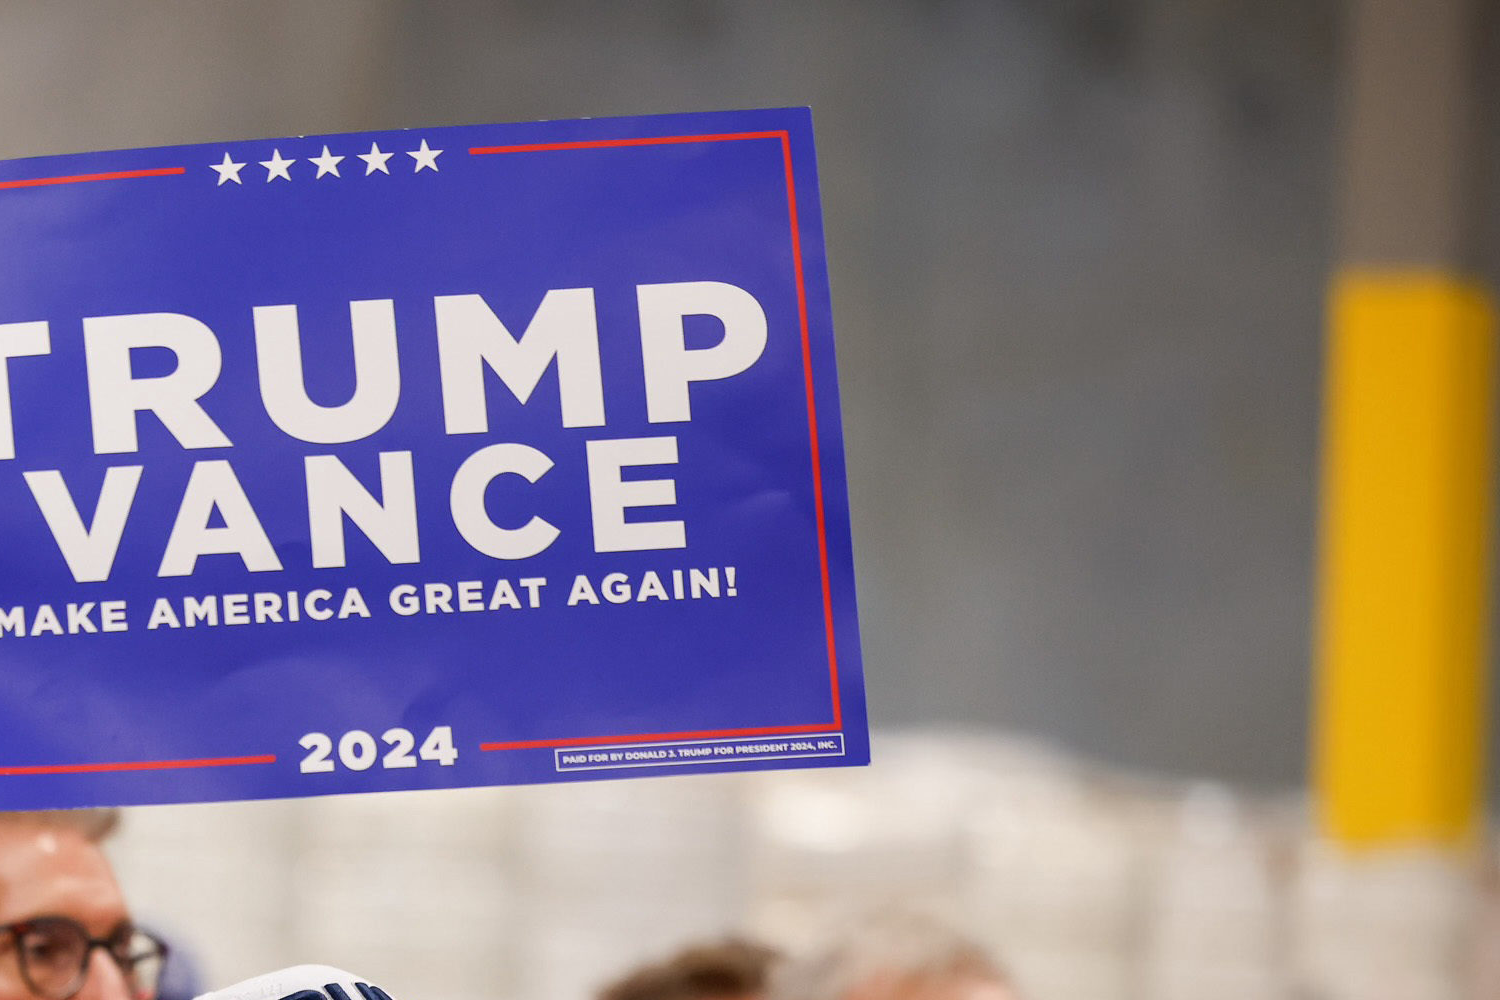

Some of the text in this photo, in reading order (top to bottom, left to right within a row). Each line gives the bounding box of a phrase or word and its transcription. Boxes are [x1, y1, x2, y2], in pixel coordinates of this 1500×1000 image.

[22, 436, 687, 583] VANCE
[147, 587, 371, 630] AMERICA
[389, 577, 547, 616] GREAT
[566, 566, 738, 606] AGAIN!
[298, 726, 459, 774] 2024
[562, 741, 838, 765] PAID FOR BY DONALD J. TRUMP FOR PRESIDENT 2024, INC.
